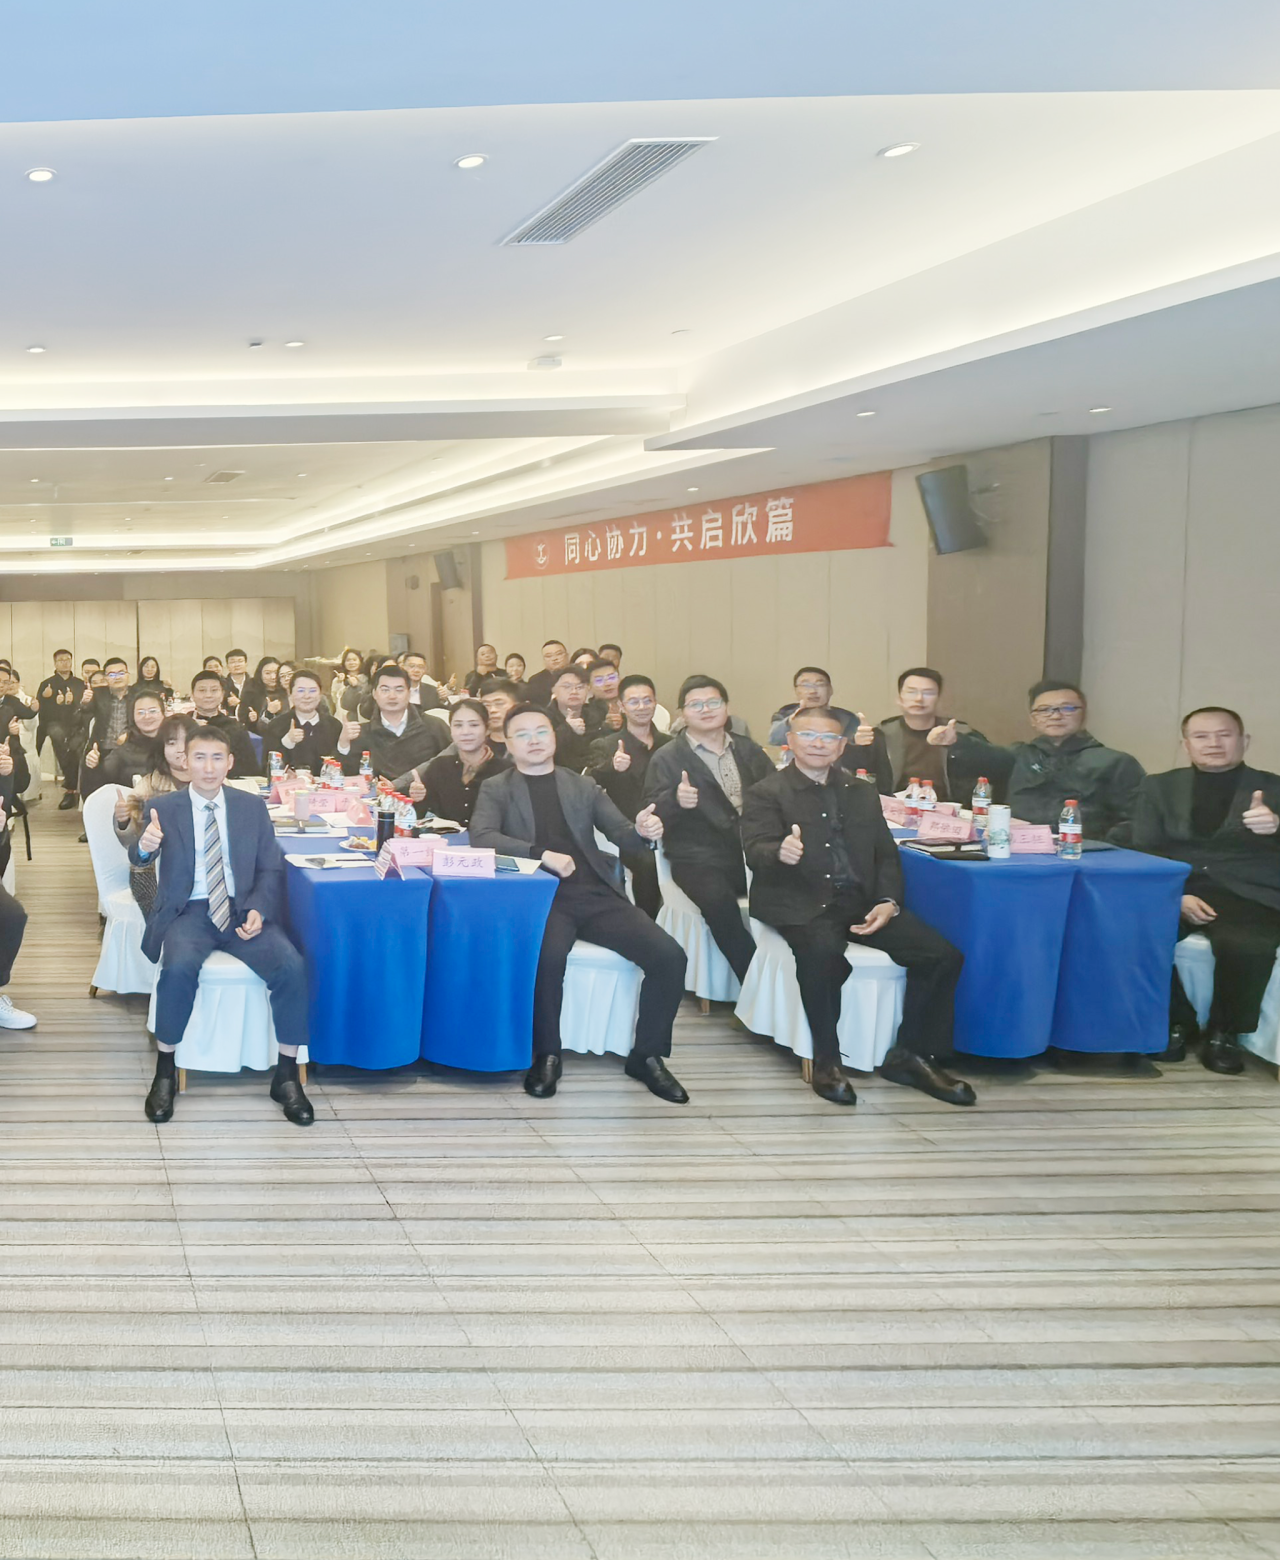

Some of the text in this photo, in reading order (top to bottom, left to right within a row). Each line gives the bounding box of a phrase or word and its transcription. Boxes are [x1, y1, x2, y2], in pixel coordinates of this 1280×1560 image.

[564, 497, 795, 566] 同心协力·共启欣篇
